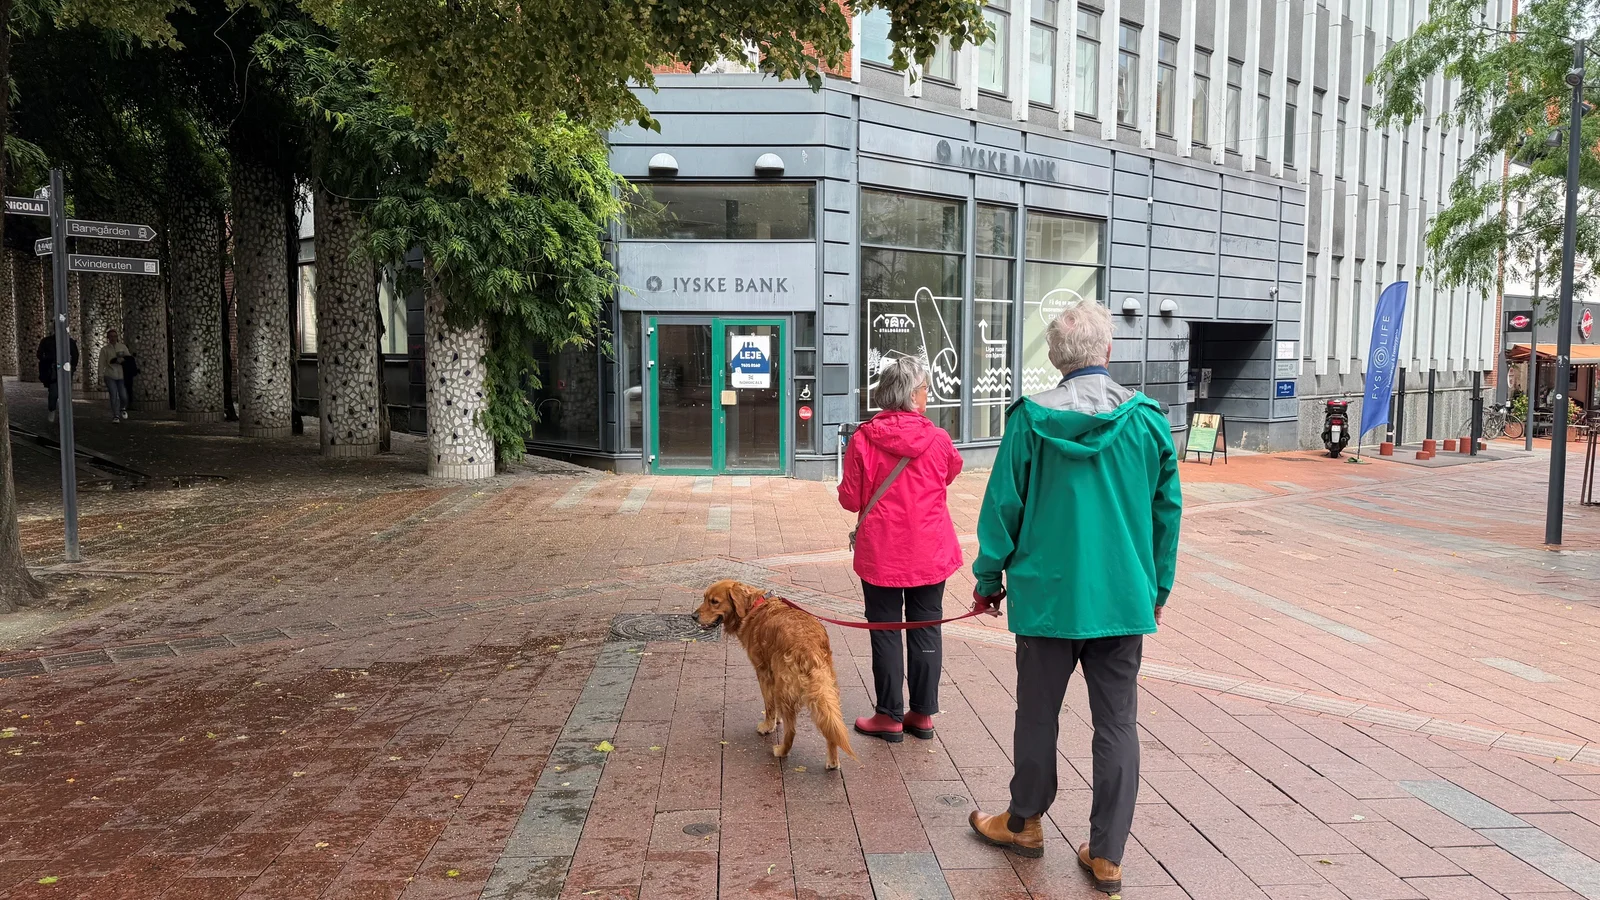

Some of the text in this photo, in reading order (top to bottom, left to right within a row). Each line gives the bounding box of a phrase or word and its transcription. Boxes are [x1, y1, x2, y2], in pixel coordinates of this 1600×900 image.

[961, 145, 1056, 181] JYSKE BANK
[74, 259, 132, 270] Kvinderuten
[672, 277, 789, 293] JYSKE BANK
[740, 351, 762, 360] LEJE
